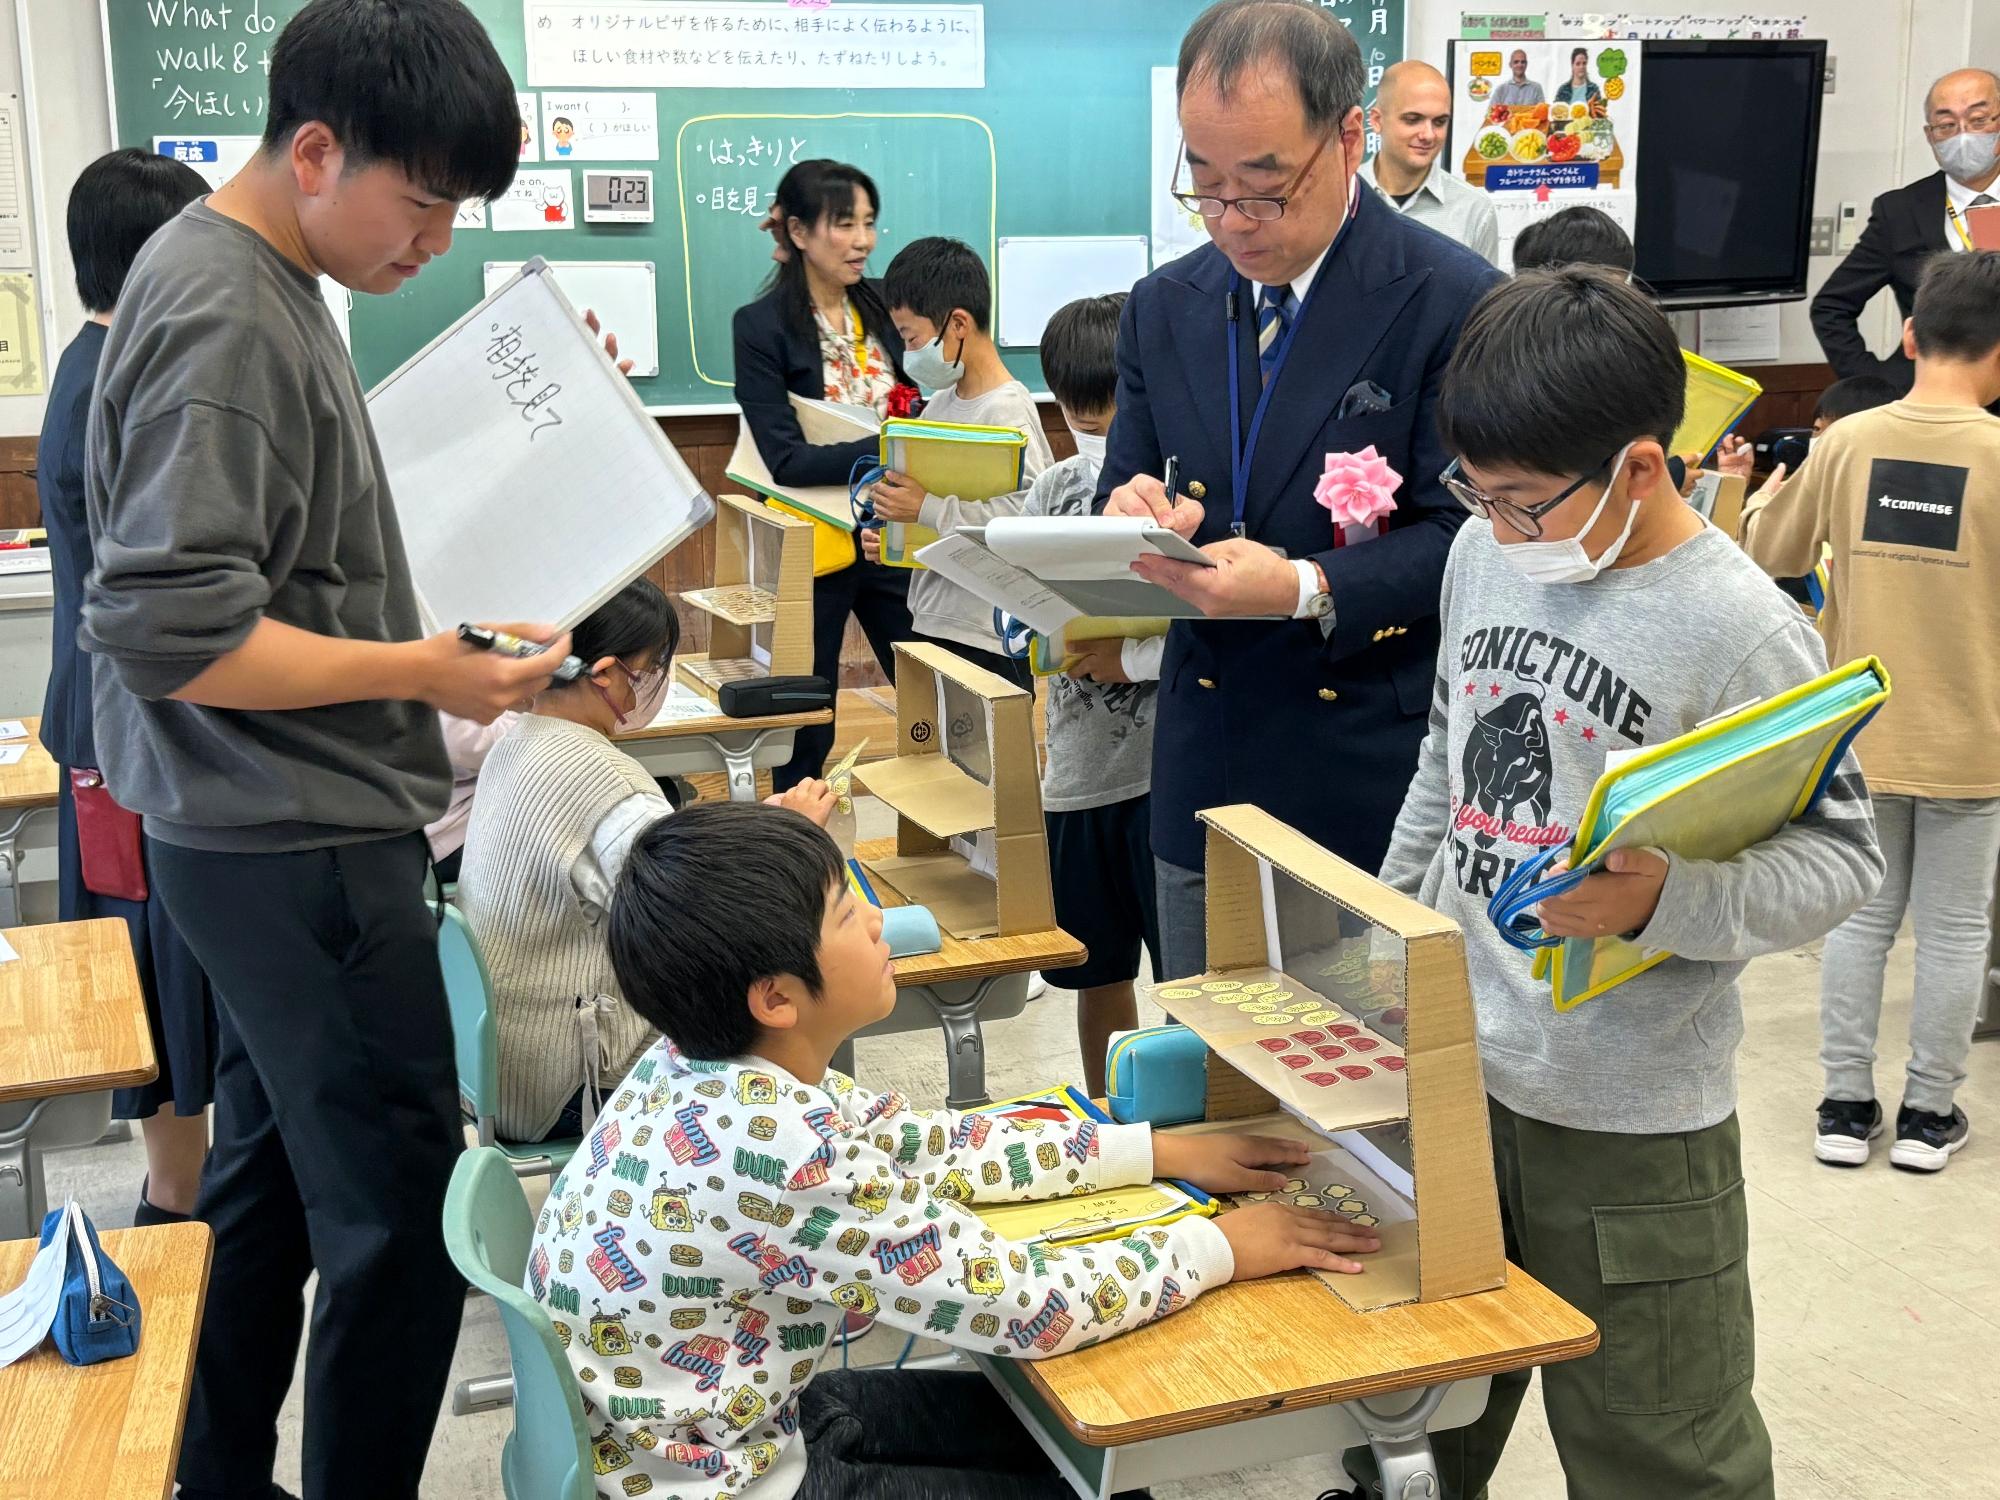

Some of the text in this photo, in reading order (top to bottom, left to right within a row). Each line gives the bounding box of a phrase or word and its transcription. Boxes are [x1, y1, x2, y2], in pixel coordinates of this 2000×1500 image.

[147, 0, 276, 34] What do
[537, 15, 552, 30] め
[555, 101, 581, 111] want
[709, 135, 807, 166] はっきりと
[1891, 498, 1954, 516] CONVERSE
[733, 1147, 788, 1191] DUDE
[662, 1273, 725, 1298] DUDE
[608, 1394, 666, 1422] DUDE
